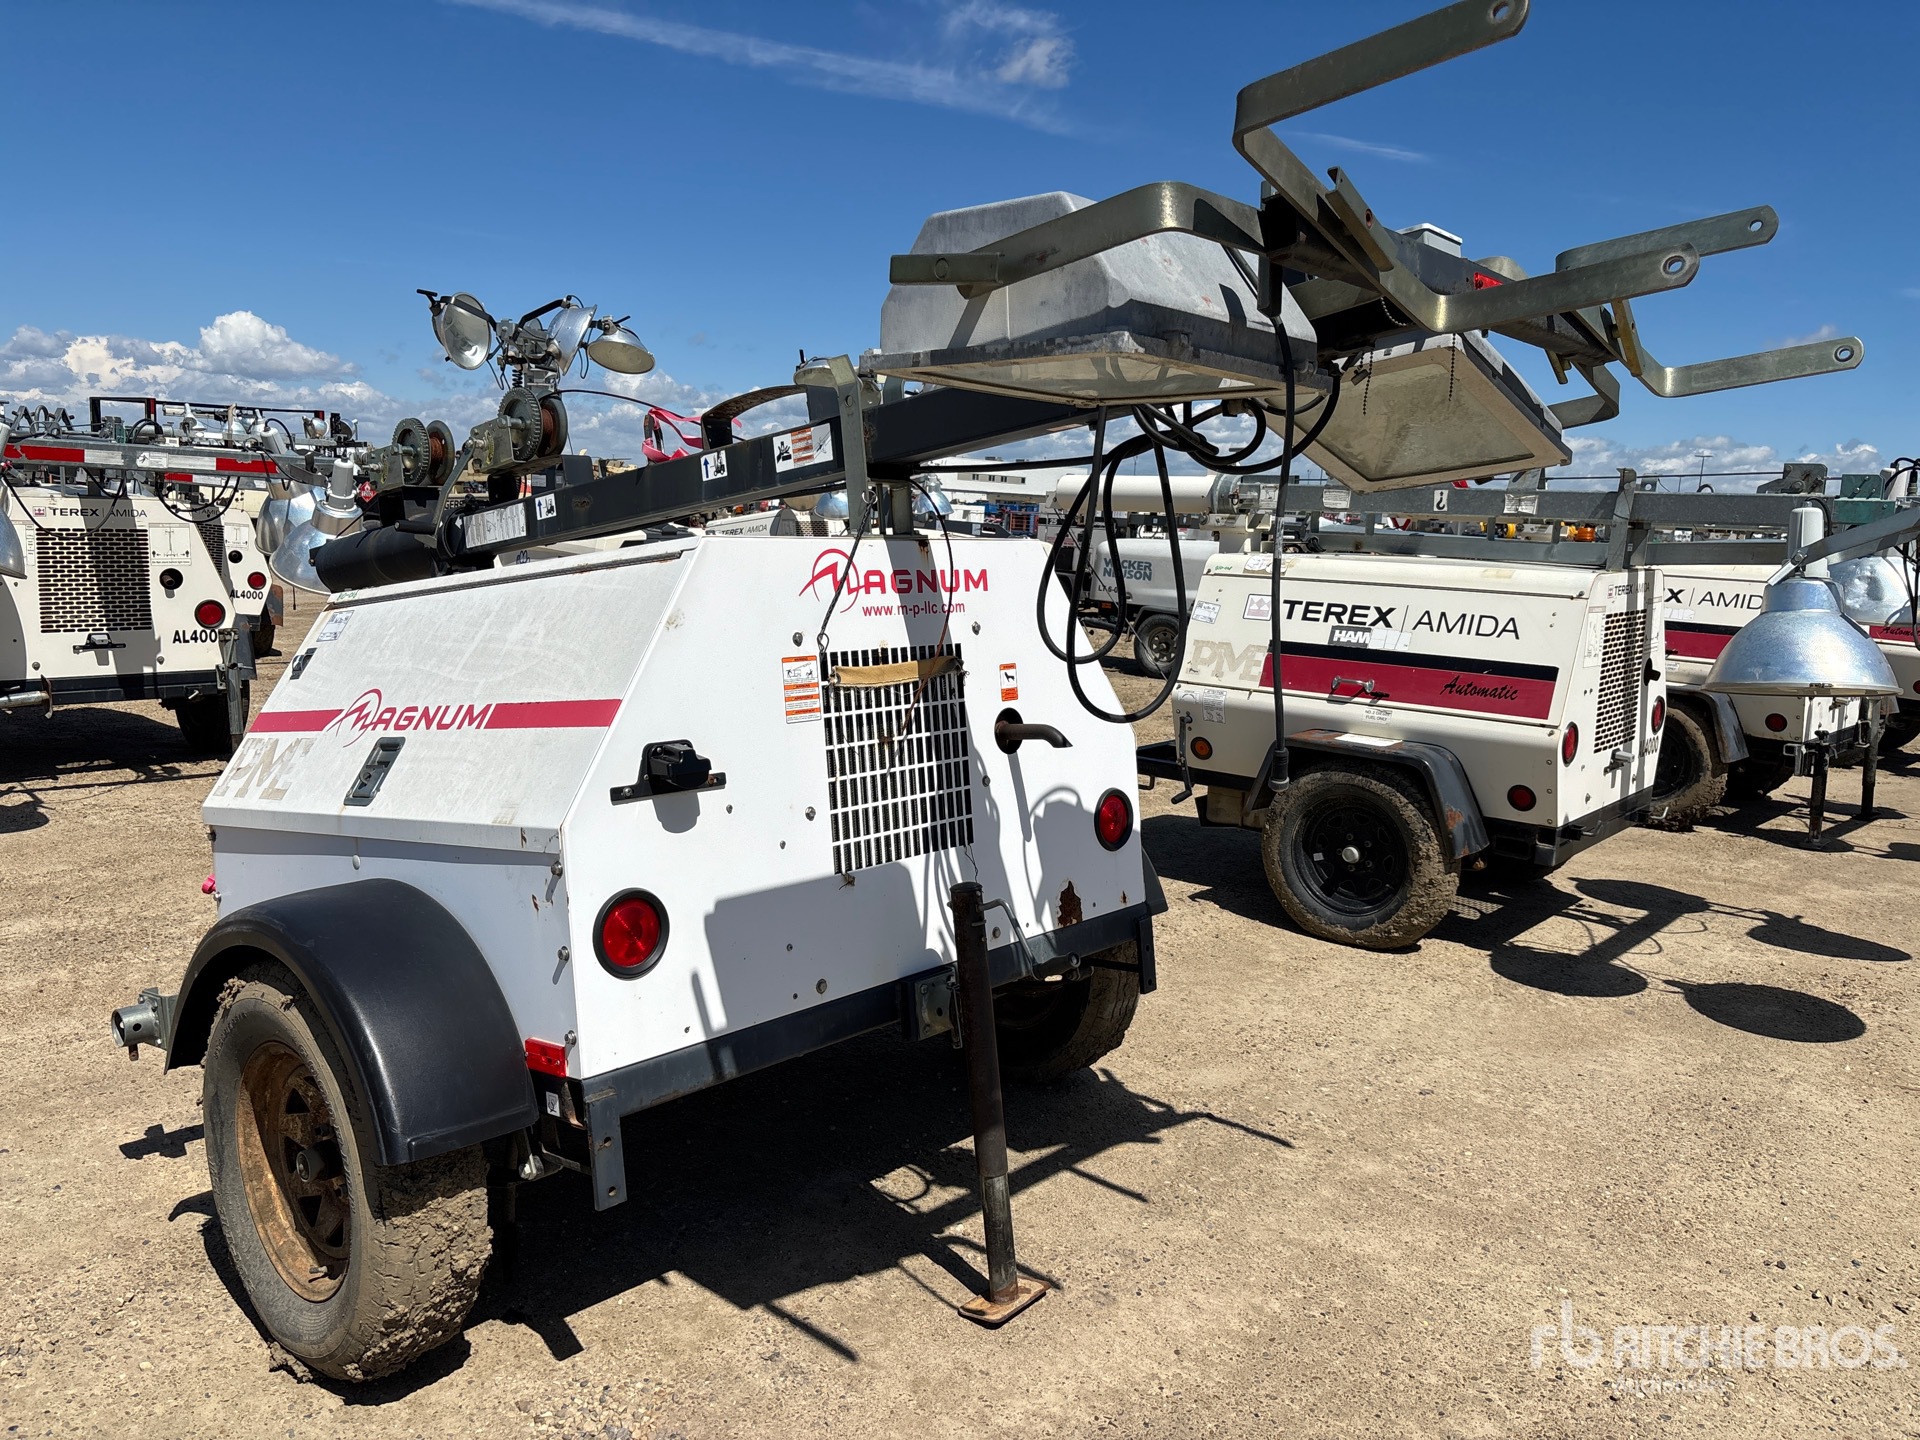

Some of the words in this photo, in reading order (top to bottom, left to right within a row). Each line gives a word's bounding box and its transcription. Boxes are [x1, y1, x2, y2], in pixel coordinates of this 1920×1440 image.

[52, 507, 99, 517] TEREX
[109, 508, 148, 518] AMIDA
[1103, 558, 1153, 572] WCKER
[798, 555, 988, 606] MAGNUM
[229, 589, 264, 600] AL4000
[1614, 584, 1633, 596] TEREX
[1697, 591, 1765, 610] AMID
[862, 601, 966, 619] www.m-p-llc.com
[1283, 599, 1397, 628] TEREX
[1412, 610, 1520, 640] AMIDA
[1440, 675, 1519, 701] Automatic
[328, 694, 496, 740] MAGNUM
